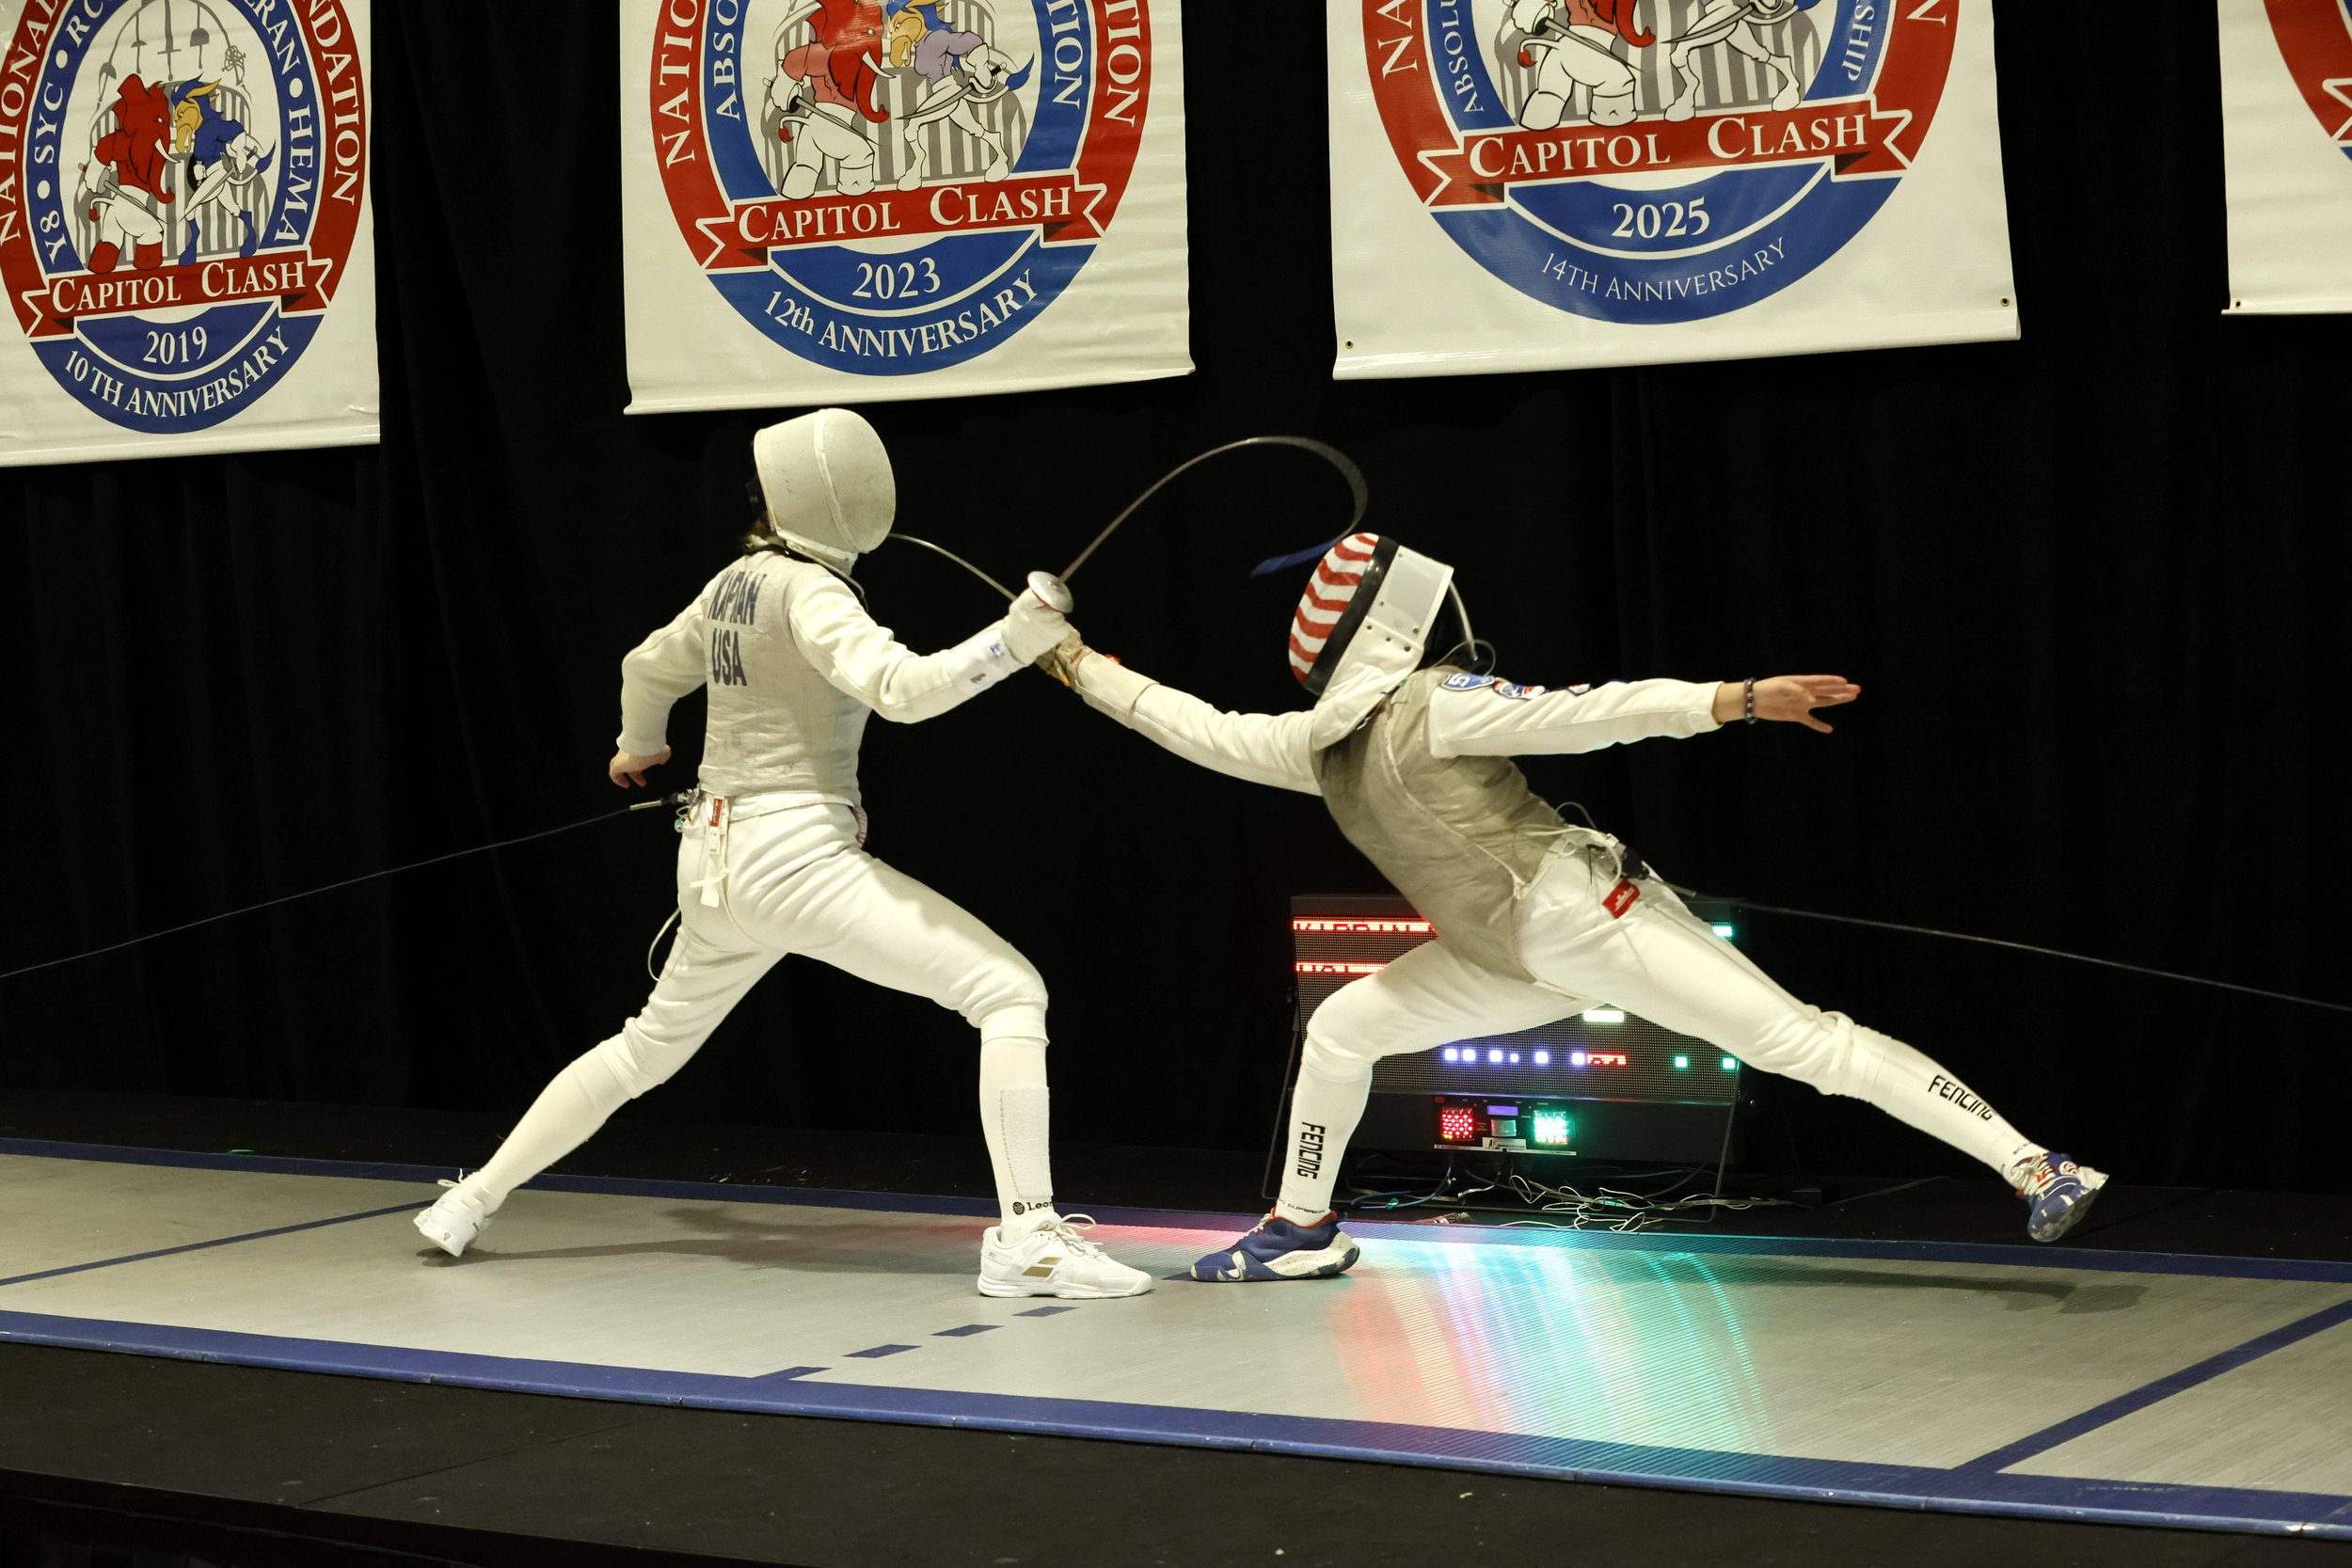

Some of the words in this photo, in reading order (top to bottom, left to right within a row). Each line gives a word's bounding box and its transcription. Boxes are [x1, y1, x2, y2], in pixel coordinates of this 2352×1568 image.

[1842, 0, 1874, 82] SHIP
[35, 82, 63, 164] SYC
[246, 0, 300, 76] RAN
[274, 104, 313, 242] HEMA
[1469, 135, 1671, 179] CAPITOL
[1707, 114, 1869, 160] CLASH
[40, 210, 68, 264] Y8
[738, 201, 901, 244] CAPITOL
[930, 186, 1072, 223] CLASH
[1612, 198, 1710, 240] 2025
[53, 277, 181, 313] CAPITOL
[201, 261, 306, 299] CLASH
[852, 258, 942, 300] 2023
[1541, 252, 1598, 294] 14TH
[1605, 237, 1786, 302] ANNIVERSARY
[764, 290, 815, 337] 12th
[818, 268, 1039, 358] ANNIVERSARY
[125, 325, 290, 418] ANNIVERSARY
[142, 328, 208, 366] 2019
[711, 627, 748, 687] USA
[1928, 1074, 1993, 1121] FENCING
[1296, 1121, 1327, 1180] FENCING
